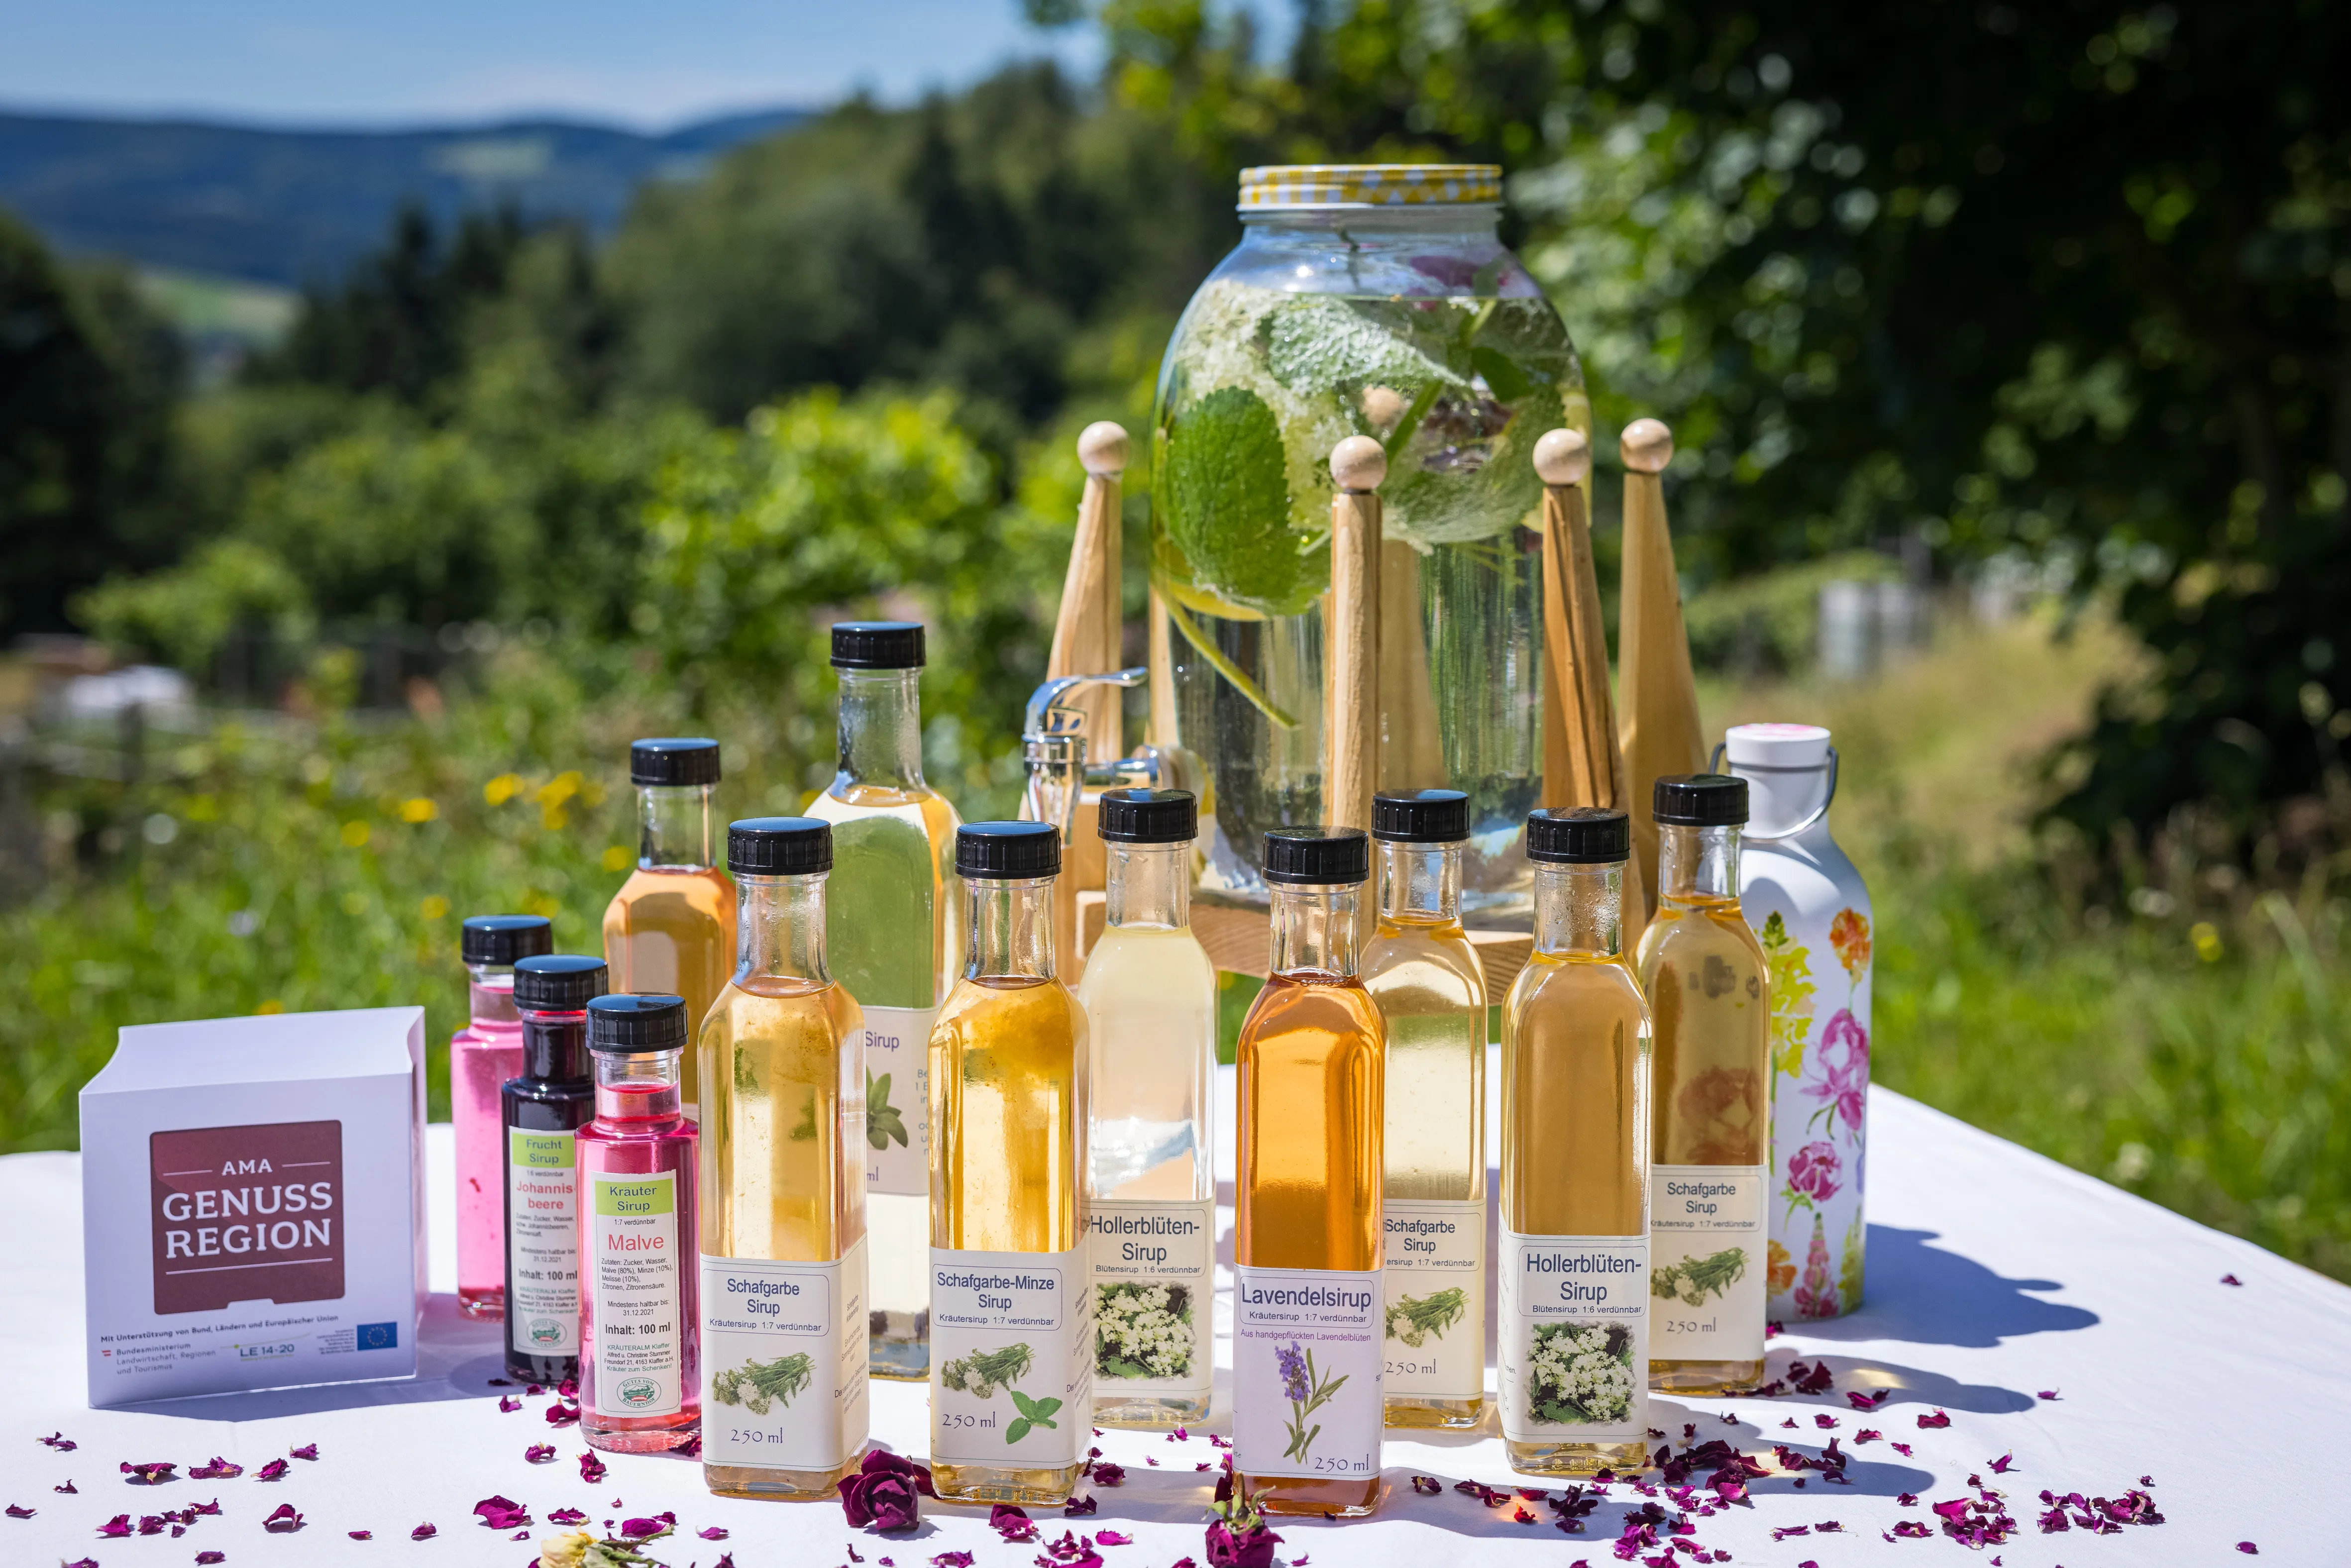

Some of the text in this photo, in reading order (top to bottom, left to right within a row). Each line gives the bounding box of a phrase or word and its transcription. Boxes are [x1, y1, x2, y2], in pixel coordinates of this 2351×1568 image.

[866, 1032, 900, 1051] Sirup
[527, 1139, 562, 1150] Frucht
[221, 1158, 273, 1175] AMA
[530, 1153, 559, 1165] Sirup
[610, 1186, 657, 1196] Kräuter
[1667, 1182, 1736, 1198] Schafgarbe
[163, 1182, 332, 1221] GENUSS
[528, 1197, 564, 1209] beere
[618, 1201, 649, 1212] Sirup
[1686, 1200, 1716, 1216] Sirup
[1091, 1215, 1199, 1235] Hollerblüten-
[1387, 1219, 1455, 1235] Schafgarbe
[165, 1218, 331, 1259] REGION
[609, 1234, 664, 1251] Malve
[1404, 1238, 1436, 1254] Sirup
[1122, 1242, 1167, 1264] Sirup
[1096, 1265, 1139, 1273] Blütensirup
[1387, 1258, 1412, 1267] ersirup
[1527, 1254, 1641, 1273] Hollerblüten-
[519, 1268, 577, 1280] Inhalt: 100 ml
[938, 1272, 1054, 1291] Schafgarbe-Minze
[727, 1278, 800, 1297] Schafgarbe
[1561, 1281, 1607, 1305] Sirup
[978, 1294, 1012, 1311] Sirup
[1242, 1283, 1371, 1312] Lavendelsirup
[747, 1299, 780, 1317] Sirup
[1532, 1305, 1578, 1314] Blütensirup
[1597, 1305, 1641, 1314] verdünnbar
[709, 1318, 757, 1329] Kräutersirup
[940, 1314, 987, 1324] Kräutersirup
[1250, 1311, 1299, 1321] Kräutersirup
[1320, 1314, 1367, 1323] verdünnbar
[116, 1330, 173, 1342] Unterstützung
[266, 1317, 314, 1328] Europäischer
[605, 1322, 670, 1335] Inhalt: 100 ml
[1667, 1317, 1716, 1334] 250 ml
[1241, 1329, 1371, 1341] Aus handgepflückten Lavendelblüten
[116, 1344, 191, 1356] Bundesministerium
[240, 1344, 294, 1357] LE 14-20
[116, 1354, 178, 1365] Landwirtschaft,
[1386, 1359, 1436, 1375] 250 ml
[135, 1364, 172, 1373] Tourismus
[623, 1397, 655, 1407] BAUERNHOF
[943, 1411, 996, 1429] 250 ml
[731, 1427, 782, 1444] 250 ml
[1315, 1454, 1369, 1472] 250 ml
